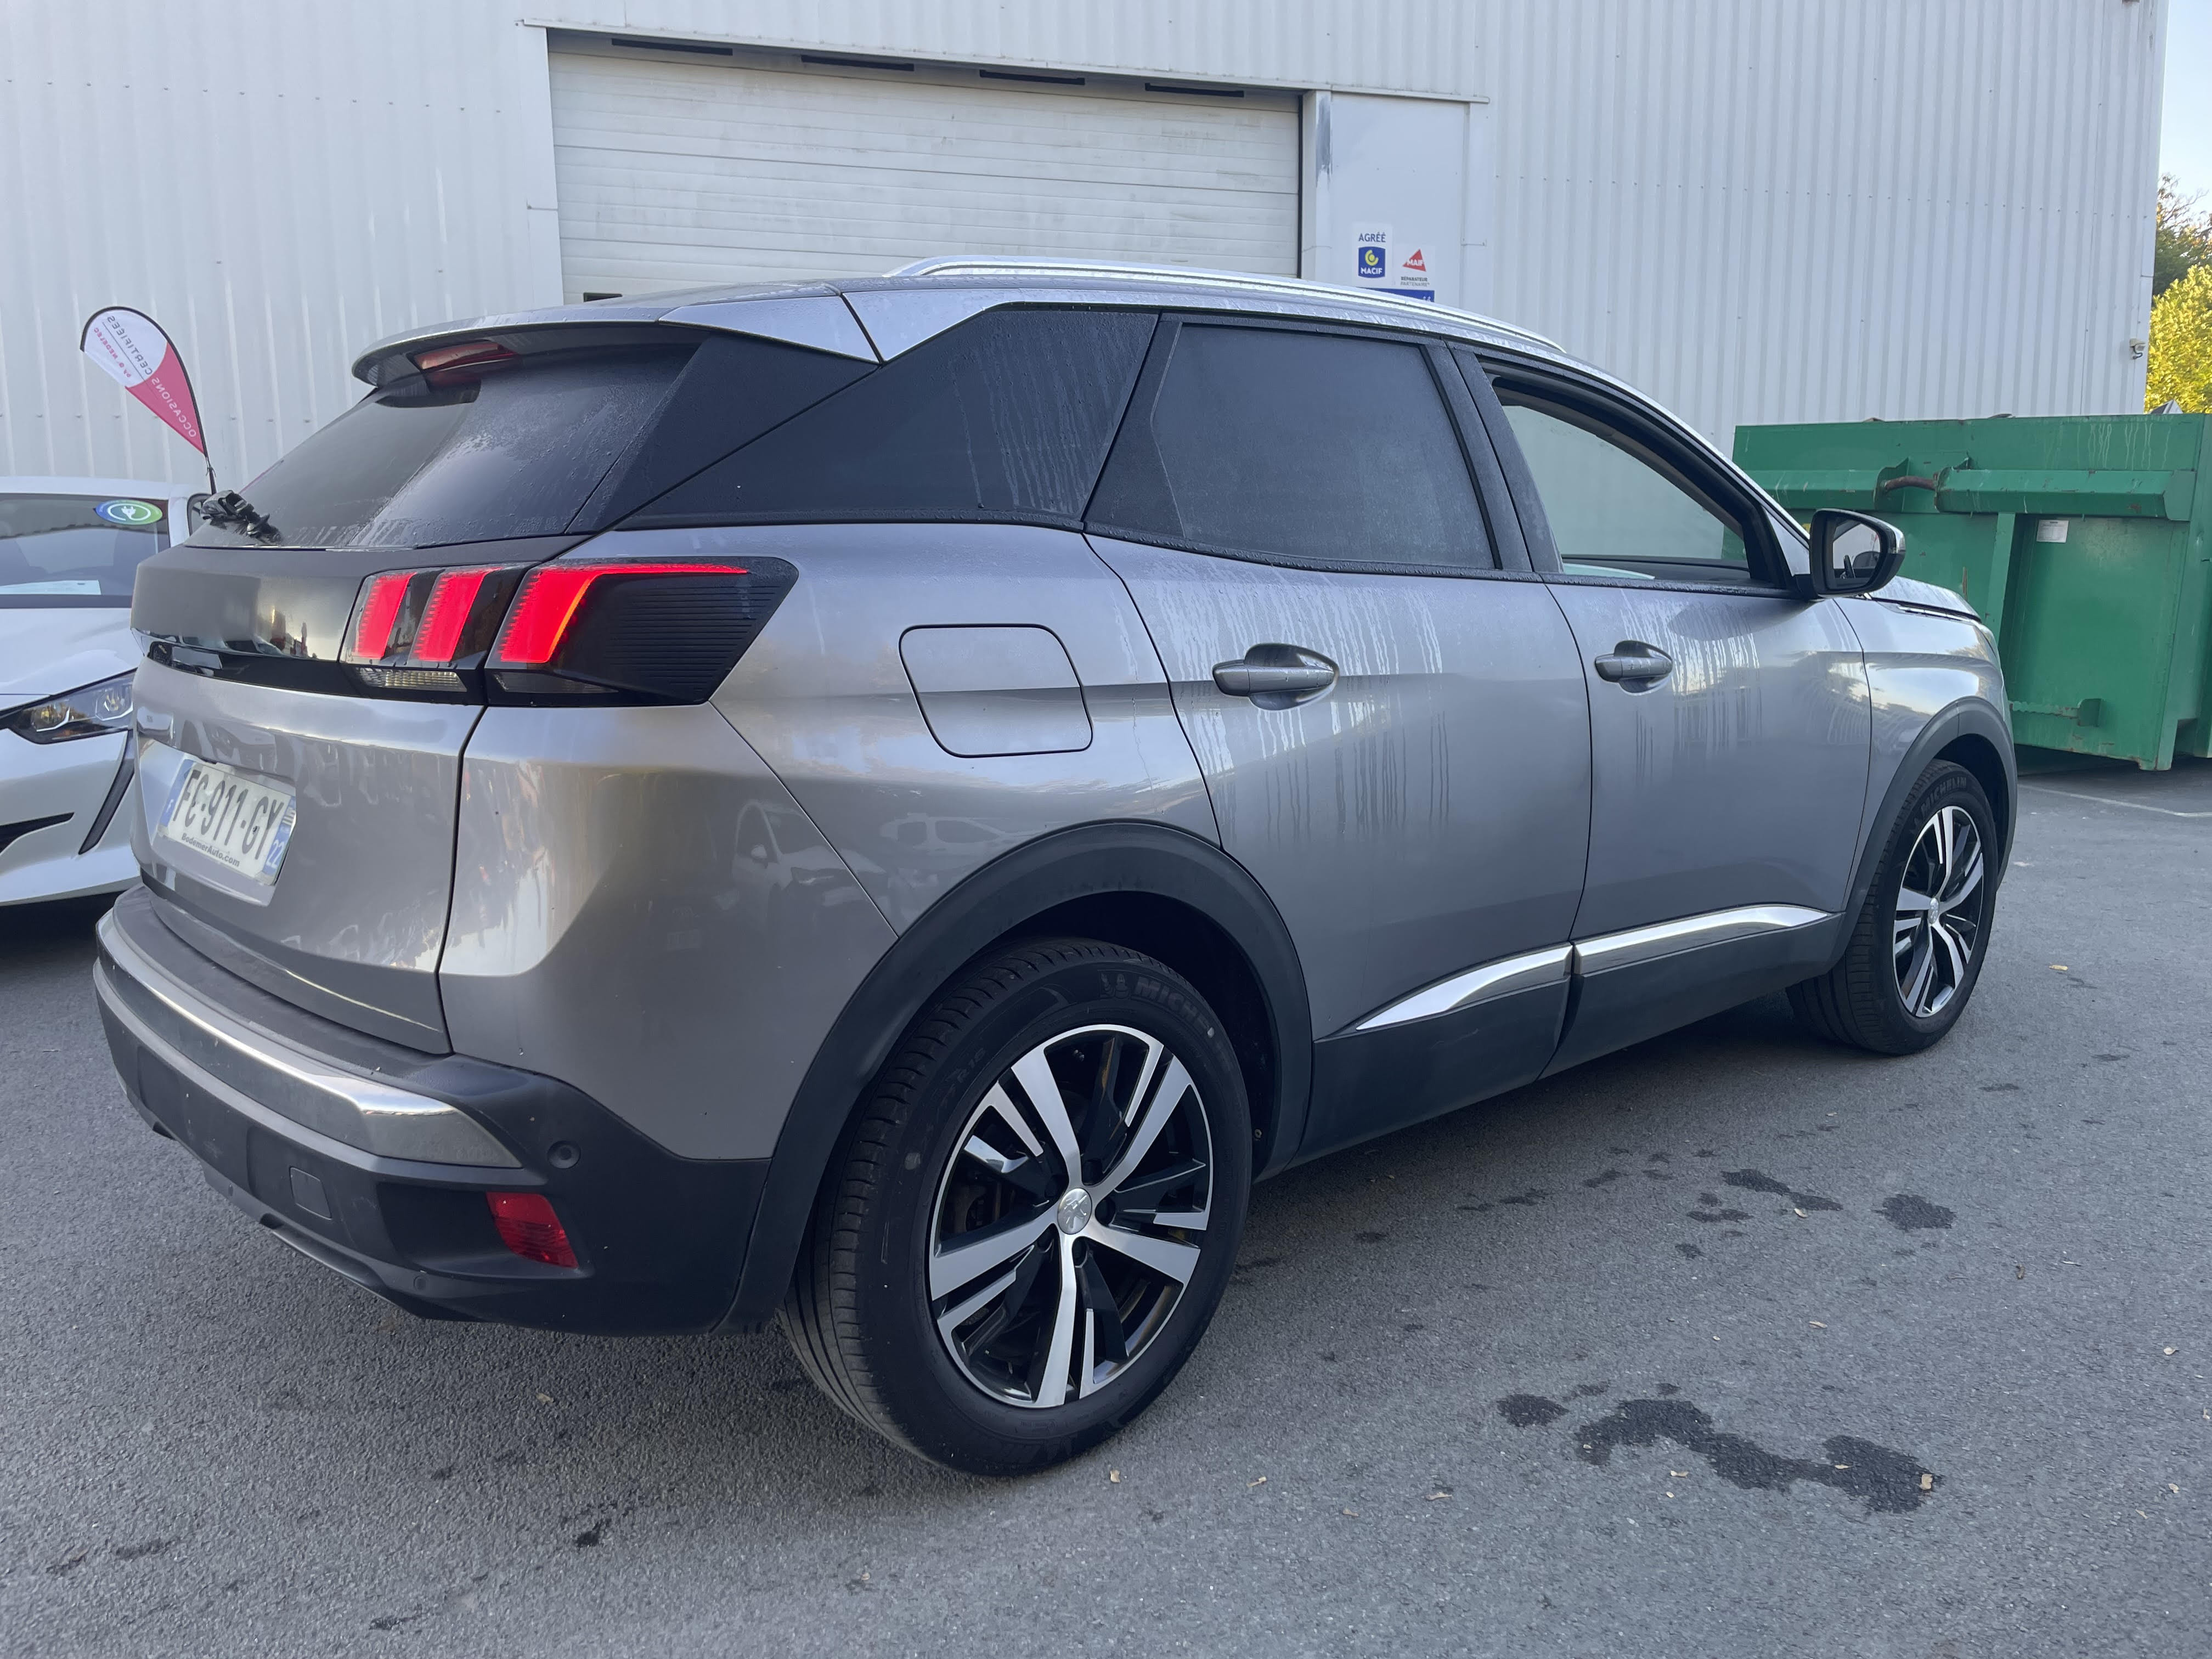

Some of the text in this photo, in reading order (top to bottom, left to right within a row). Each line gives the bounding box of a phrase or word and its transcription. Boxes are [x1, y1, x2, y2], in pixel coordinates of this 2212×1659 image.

[1358, 232, 1386, 242] AGRÉÉ
[1921, 776, 1966, 819] MICHELIN
[182, 833, 240, 867] BodemerAuto.com
[266, 839, 285, 868] 22
